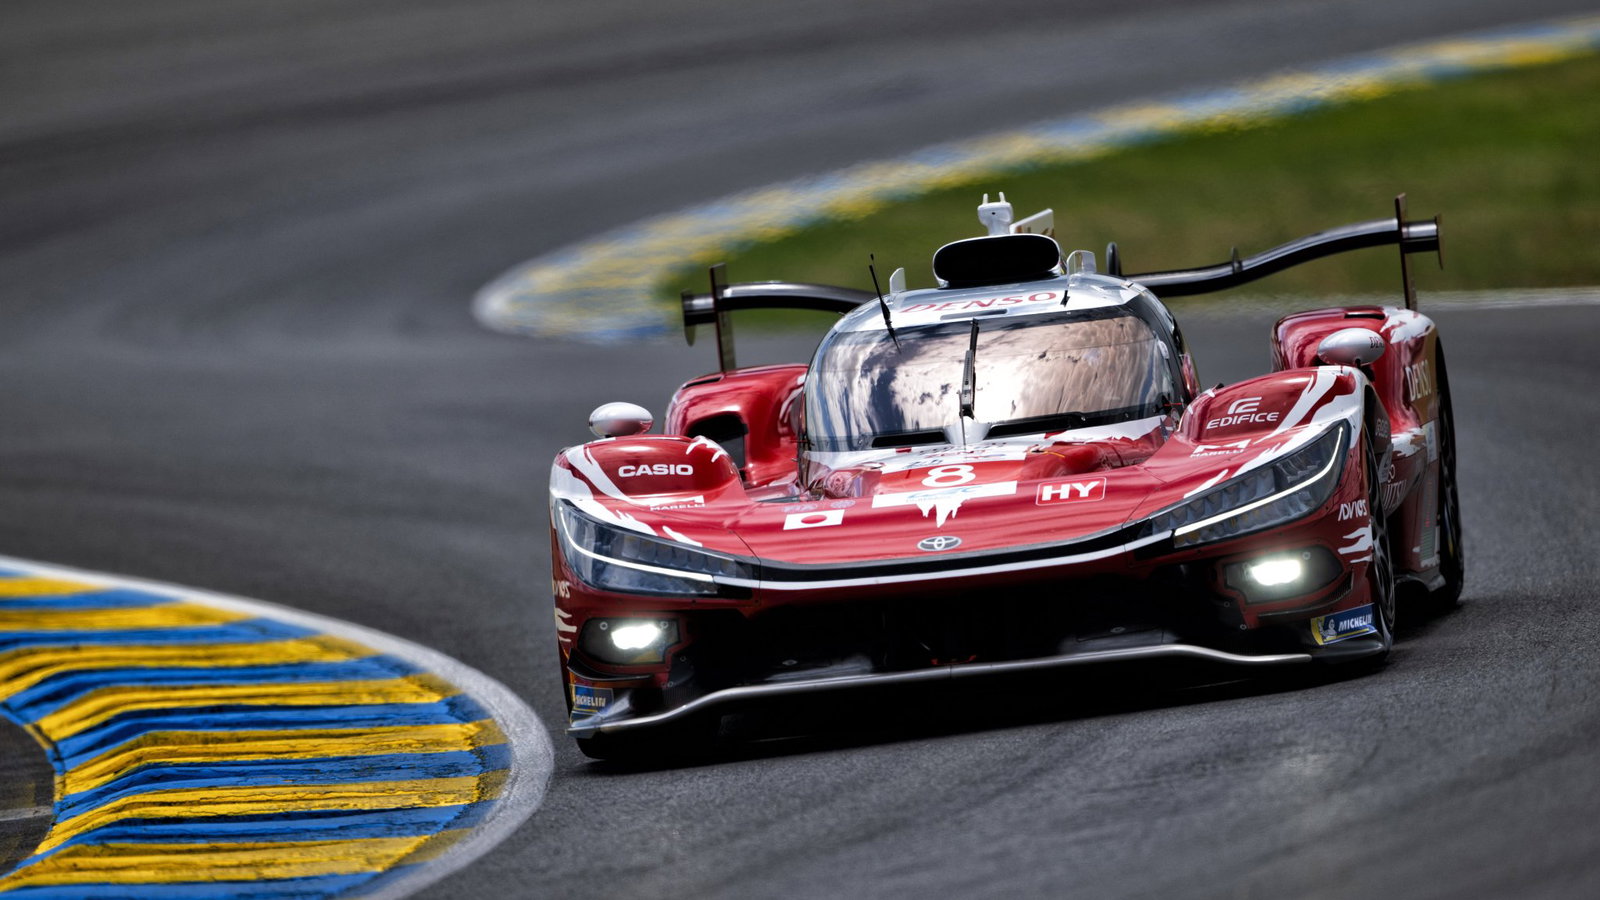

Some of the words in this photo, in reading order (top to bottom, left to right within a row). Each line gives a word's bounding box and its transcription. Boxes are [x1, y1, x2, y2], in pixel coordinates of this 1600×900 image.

[900, 292, 1057, 313] DENSO
[1206, 412, 1279, 429] EDIFICE
[1190, 448, 1244, 458] MARELLI
[618, 464, 694, 477] CASIO
[921, 464, 976, 488] 8
[1042, 481, 1099, 501] HY
[650, 502, 706, 511] MARELLI
[1338, 613, 1372, 632] MICHELIN
